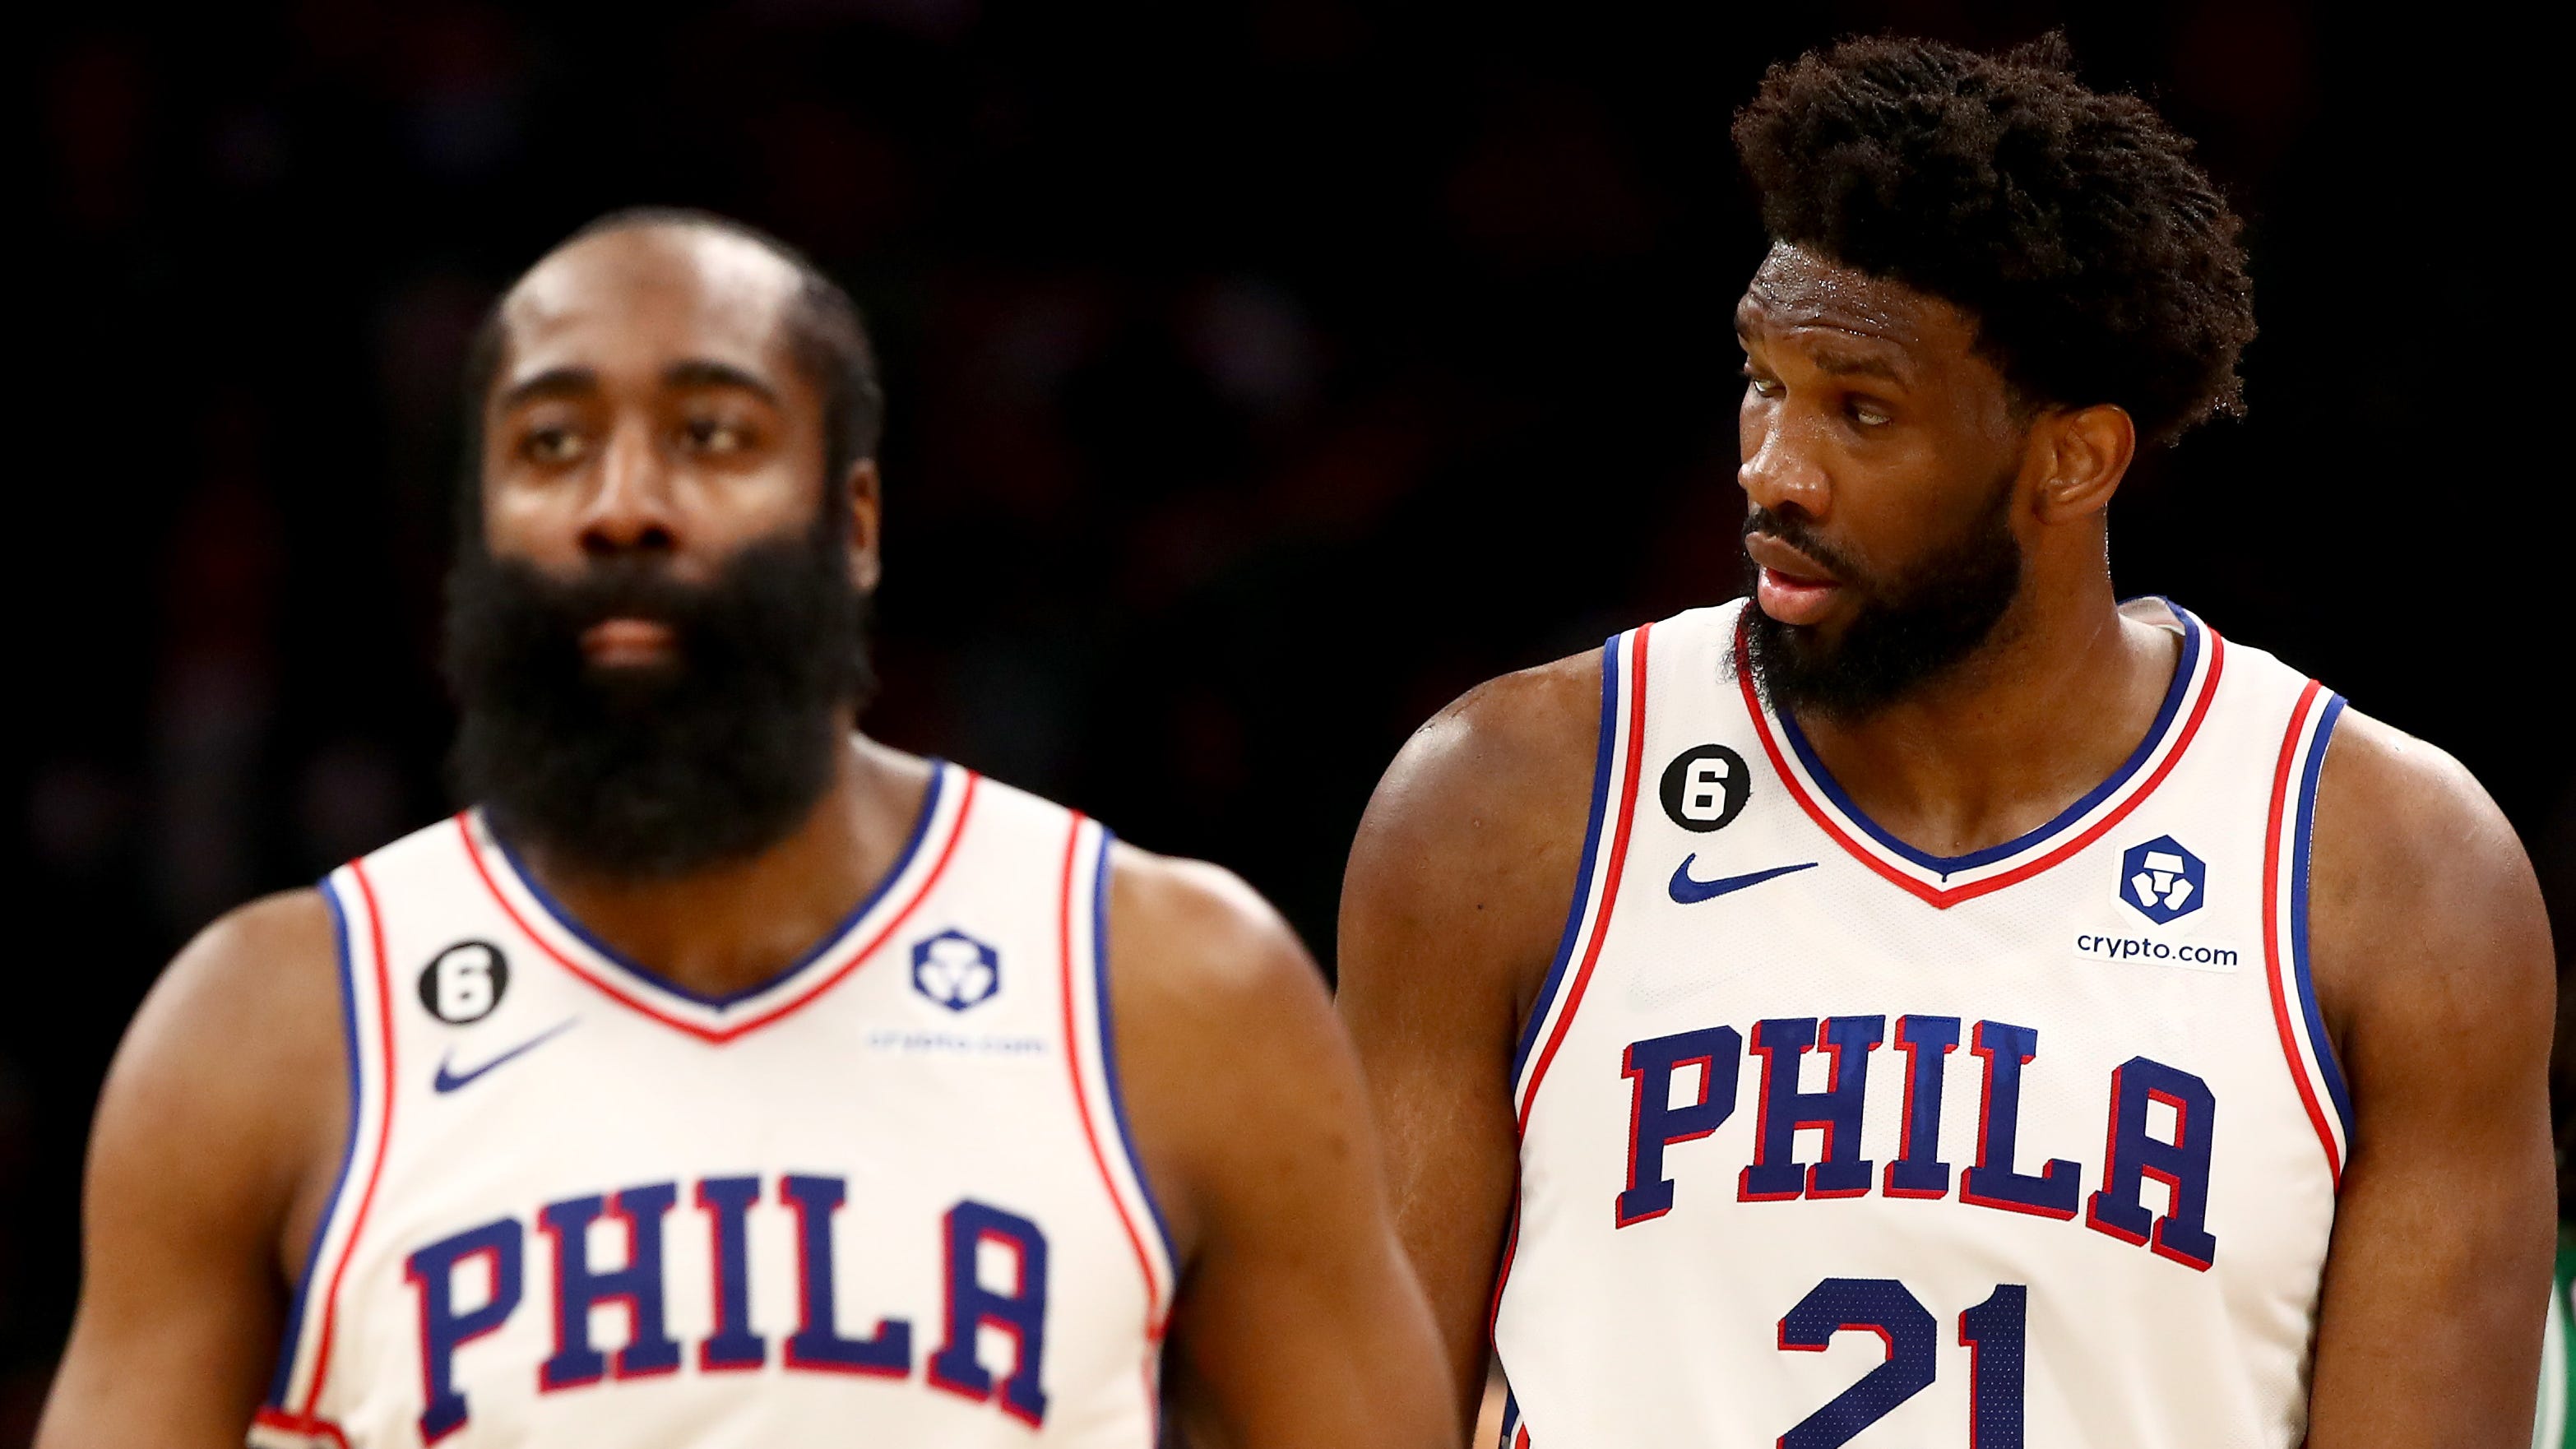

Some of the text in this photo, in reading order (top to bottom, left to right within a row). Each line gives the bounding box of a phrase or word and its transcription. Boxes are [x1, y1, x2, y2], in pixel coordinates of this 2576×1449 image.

[1680, 757, 1730, 821] 6
[438, 946, 493, 1020] 6
[2077, 933, 2239, 966] crypto.com
[1615, 1014, 2217, 1272] PHILA
[404, 1174, 1050, 1447] PHILA
[1776, 1277, 2027, 1449] 21
